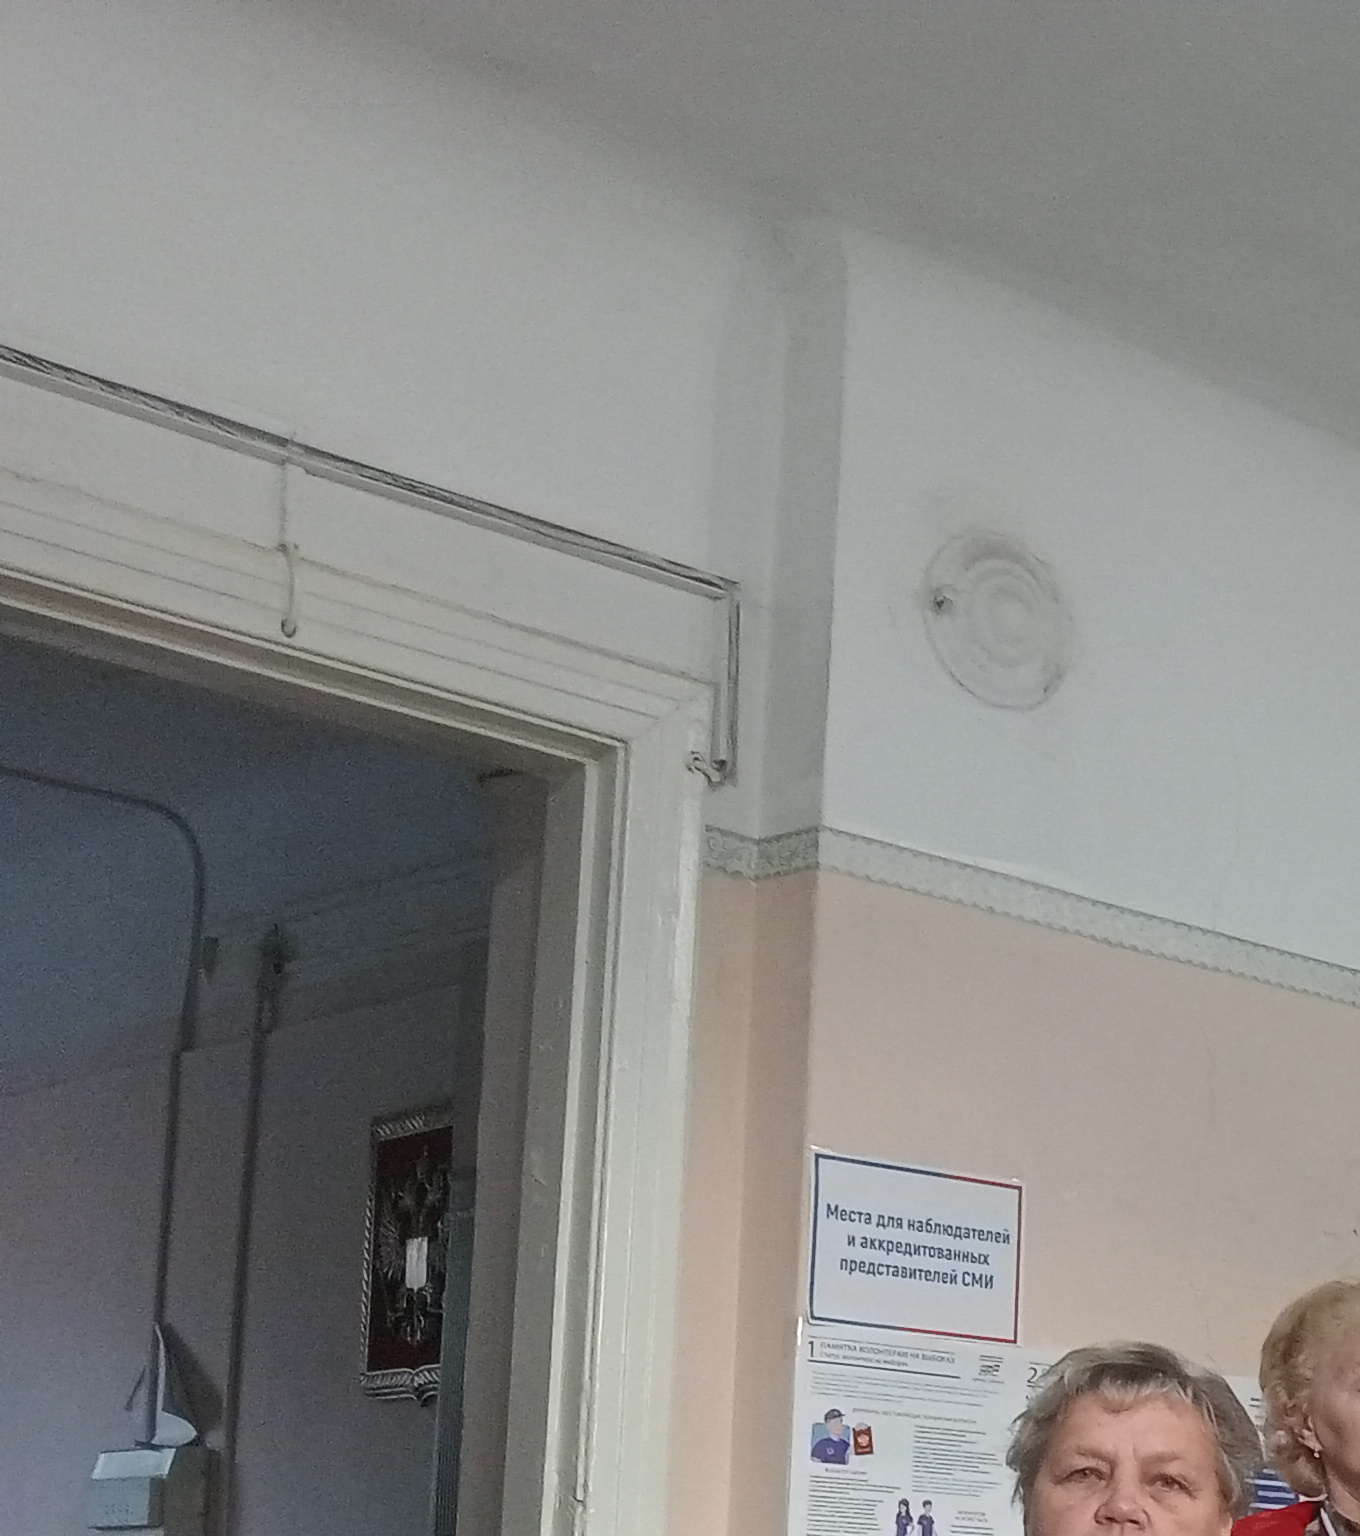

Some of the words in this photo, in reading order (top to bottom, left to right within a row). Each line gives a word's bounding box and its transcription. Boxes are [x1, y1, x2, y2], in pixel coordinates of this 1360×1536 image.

[826, 1203, 872, 1225] Места
[876, 1213, 903, 1230] для
[907, 1218, 1010, 1245] наблюдателей
[847, 1232, 856, 1248] и
[860, 1235, 991, 1266] аккредитованных
[839, 1257, 958, 1286] представителей
[961, 1270, 994, 1290] СМИ
[807, 1340, 815, 1358] 1
[1026, 1366, 1038, 1384] 2
